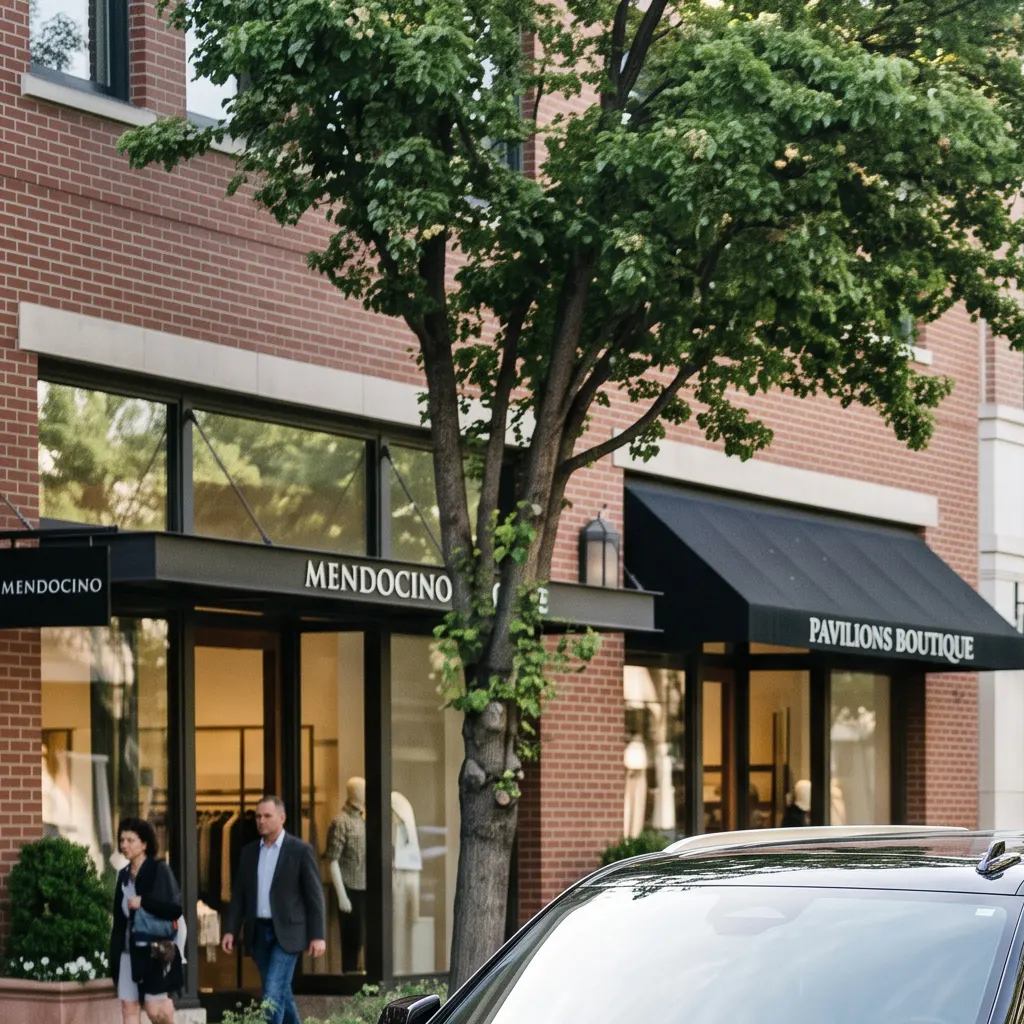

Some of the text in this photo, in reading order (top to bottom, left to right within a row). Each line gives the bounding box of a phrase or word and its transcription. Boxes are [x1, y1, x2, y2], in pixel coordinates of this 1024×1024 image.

[1, 578, 102, 595] MENDOCINO
[305, 560, 453, 603] MENDOCINO
[809, 617, 975, 664] PAVILIONS BOUTIQUE
